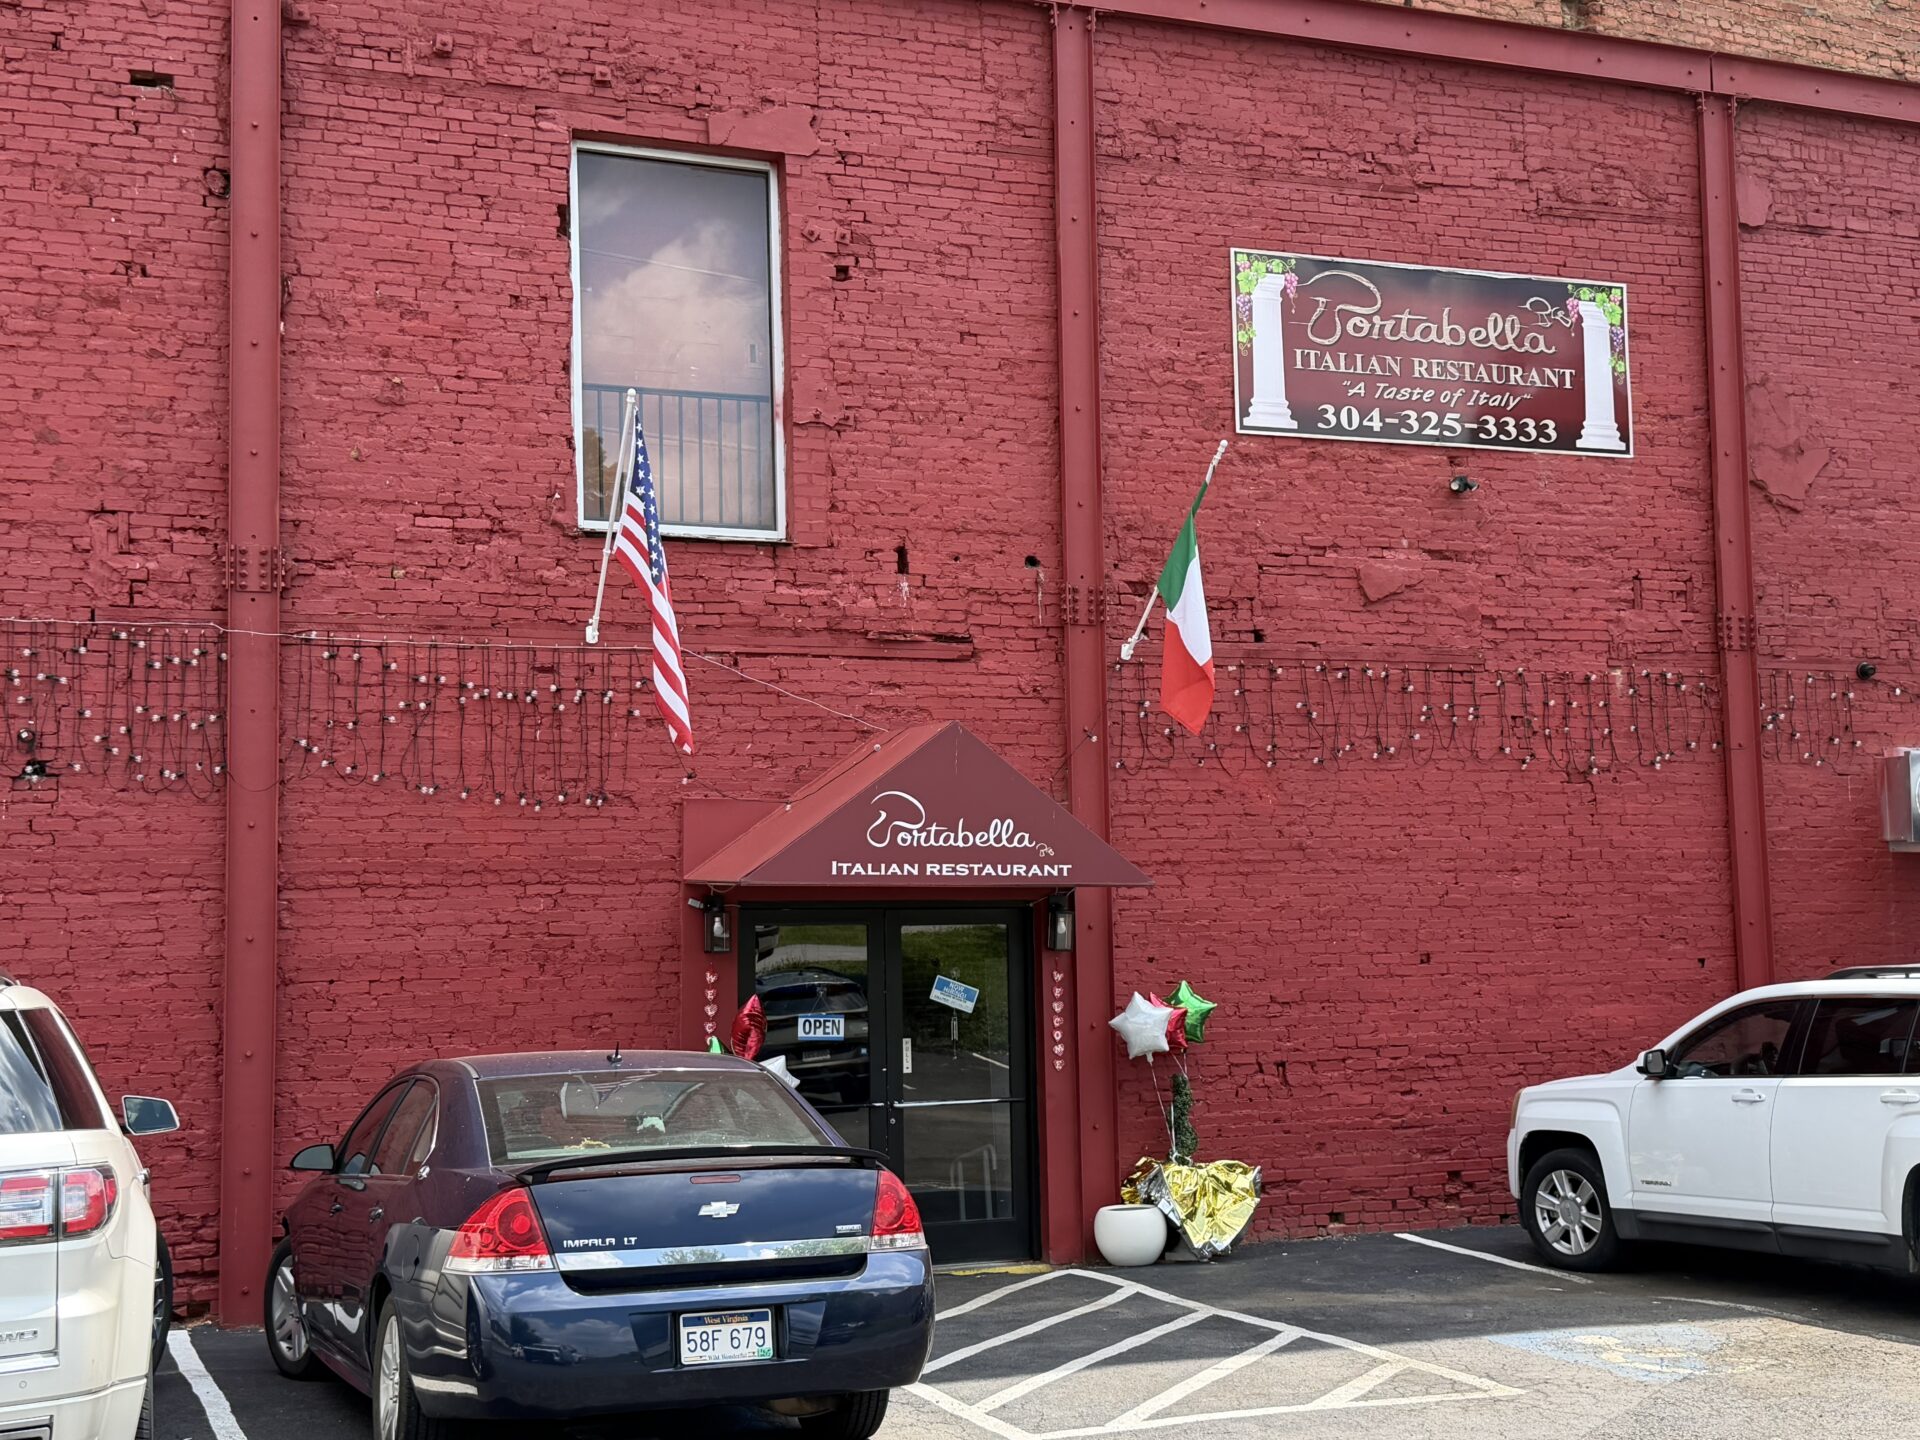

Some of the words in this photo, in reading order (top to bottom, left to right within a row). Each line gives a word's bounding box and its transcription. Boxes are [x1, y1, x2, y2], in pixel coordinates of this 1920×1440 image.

[1300, 269, 1557, 354] Portabella
[1293, 348, 1402, 376] ITALIAN
[1412, 356, 1576, 389] RESTAURANT
[1375, 382, 1435, 403] Taste
[1440, 388, 1466, 406] of
[1316, 403, 1558, 444] 304-325-3333
[866, 790, 1036, 848] Portabella
[926, 862, 1073, 878] RESTAURANT
[802, 1019, 841, 1035] OPEN
[1052, 970, 1065, 1071] WELCOME
[563, 1237, 616, 1249] IMPALA
[623, 1236, 638, 1246] LT
[704, 1316, 721, 1325] West
[722, 1314, 749, 1324] Virginia
[686, 1329, 722, 1353] 58F
[730, 1327, 766, 1349] 679
